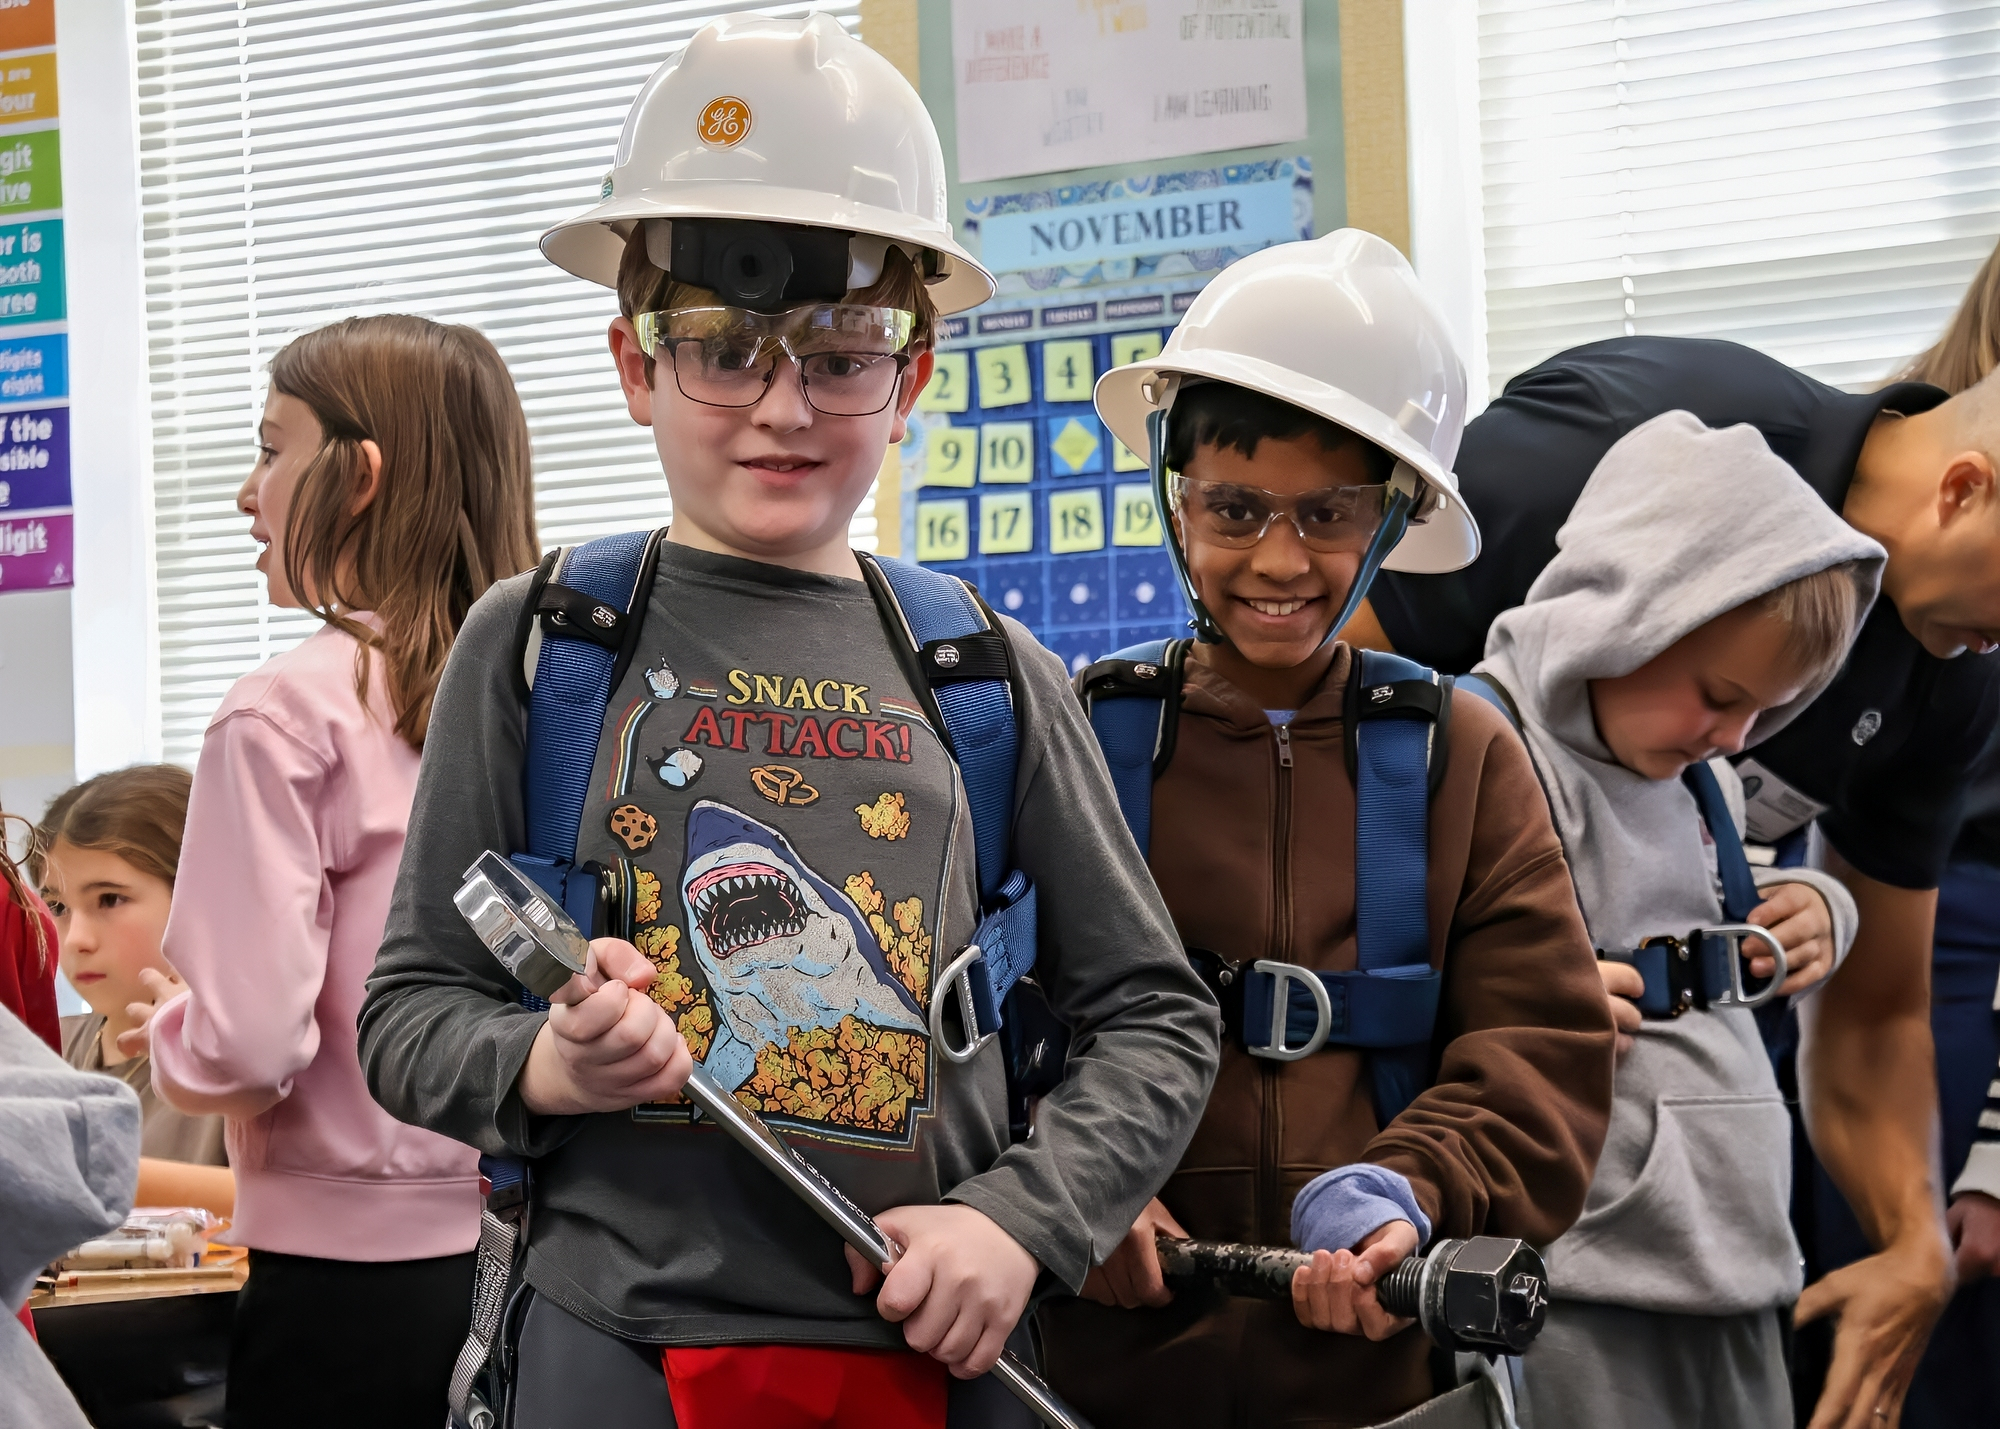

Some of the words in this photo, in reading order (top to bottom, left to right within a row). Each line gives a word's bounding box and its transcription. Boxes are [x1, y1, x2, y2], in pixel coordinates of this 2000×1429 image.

[1030, 199, 1244, 257] NOVEMBER
[934, 367, 950, 399] 2
[991, 360, 1012, 394] 3
[1057, 354, 1079, 389] 4
[10, 413, 53, 443] the
[941, 438, 961, 473] 9
[990, 438, 1025, 469] 10
[926, 515, 958, 547] 16
[991, 507, 1021, 541] 17
[1060, 507, 1092, 540] 18
[1124, 501, 1154, 533] 19
[725, 668, 871, 715] SNACK
[683, 706, 911, 763] ATTACK!
